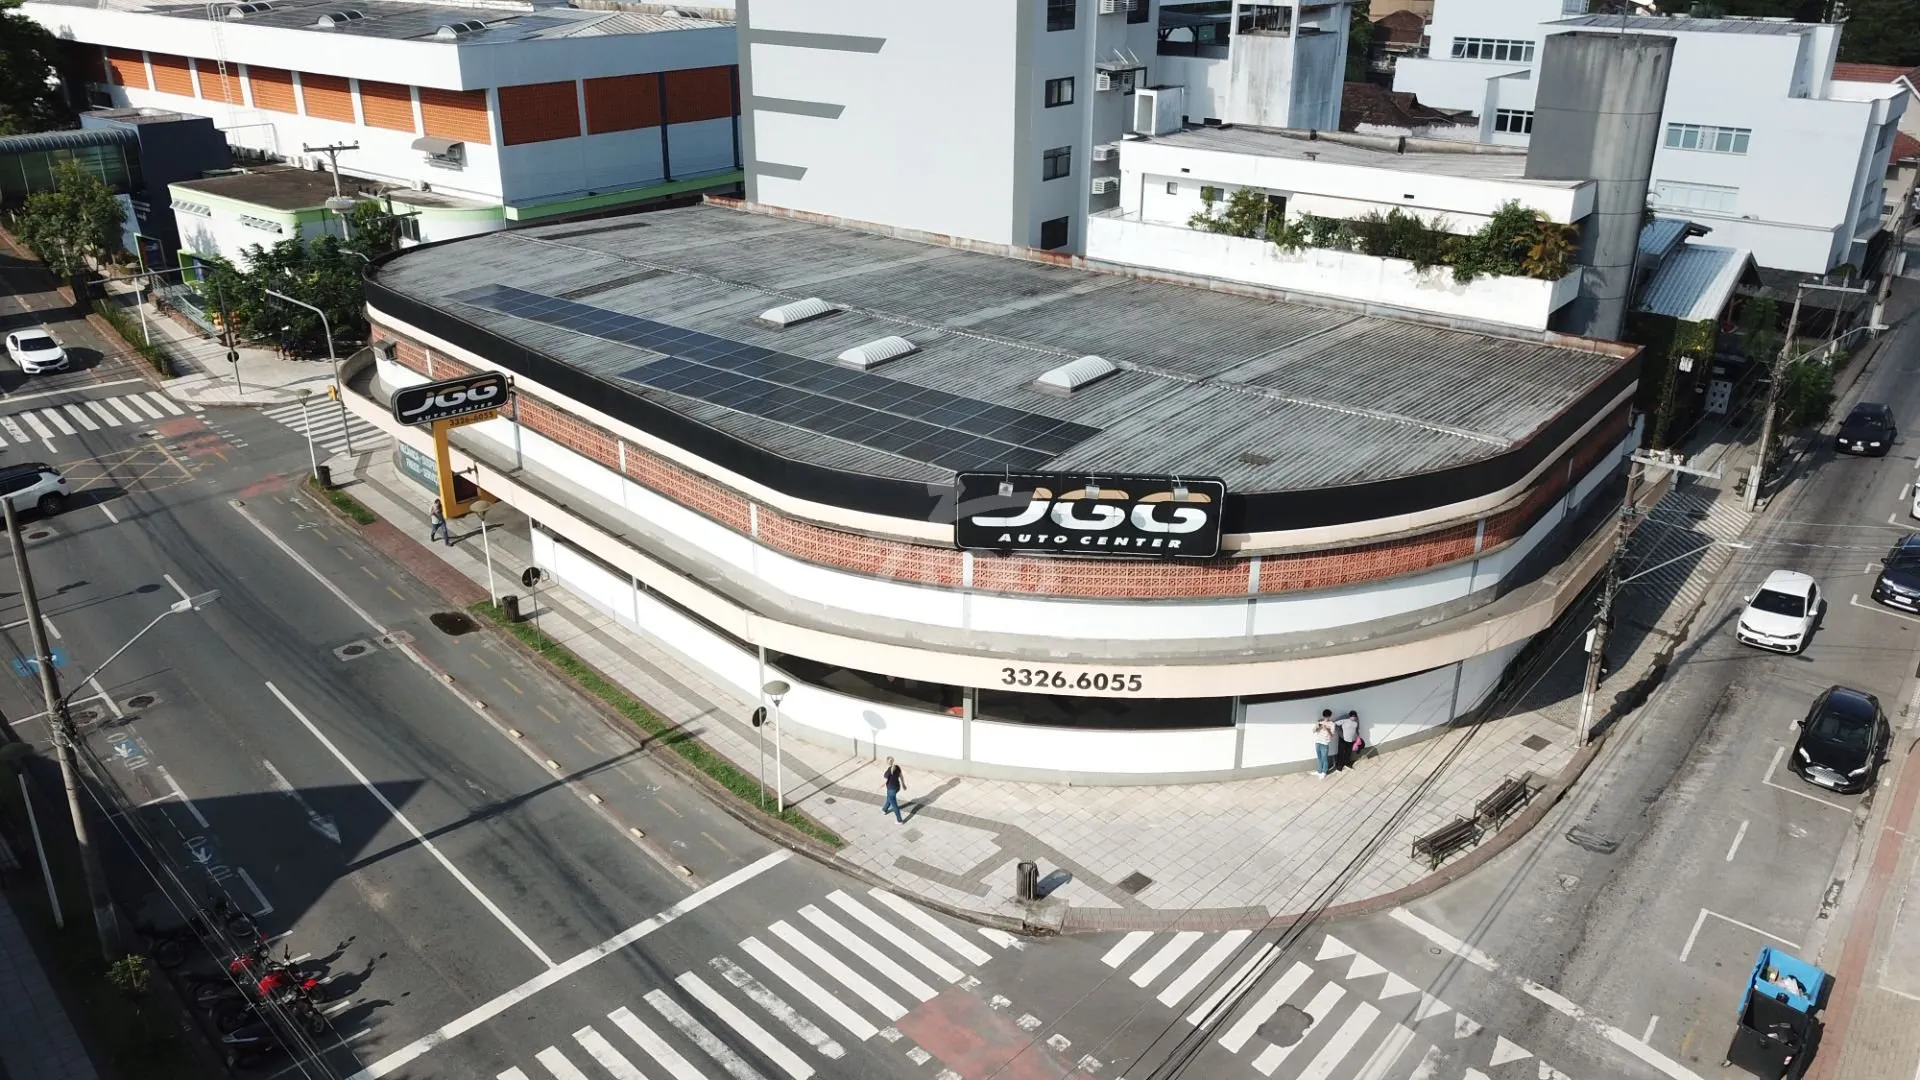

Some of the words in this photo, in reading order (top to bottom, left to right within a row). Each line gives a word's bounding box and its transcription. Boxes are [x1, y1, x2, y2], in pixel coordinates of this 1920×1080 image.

[402, 379, 498, 417] JGG
[417, 412, 447, 421] AUTO
[451, 401, 494, 414] CENTER
[971, 487, 1212, 534] JGG
[998, 533, 1068, 544] AUTO
[1079, 535, 1182, 549] CENTER
[1001, 667, 1142, 692] 3326.6055
